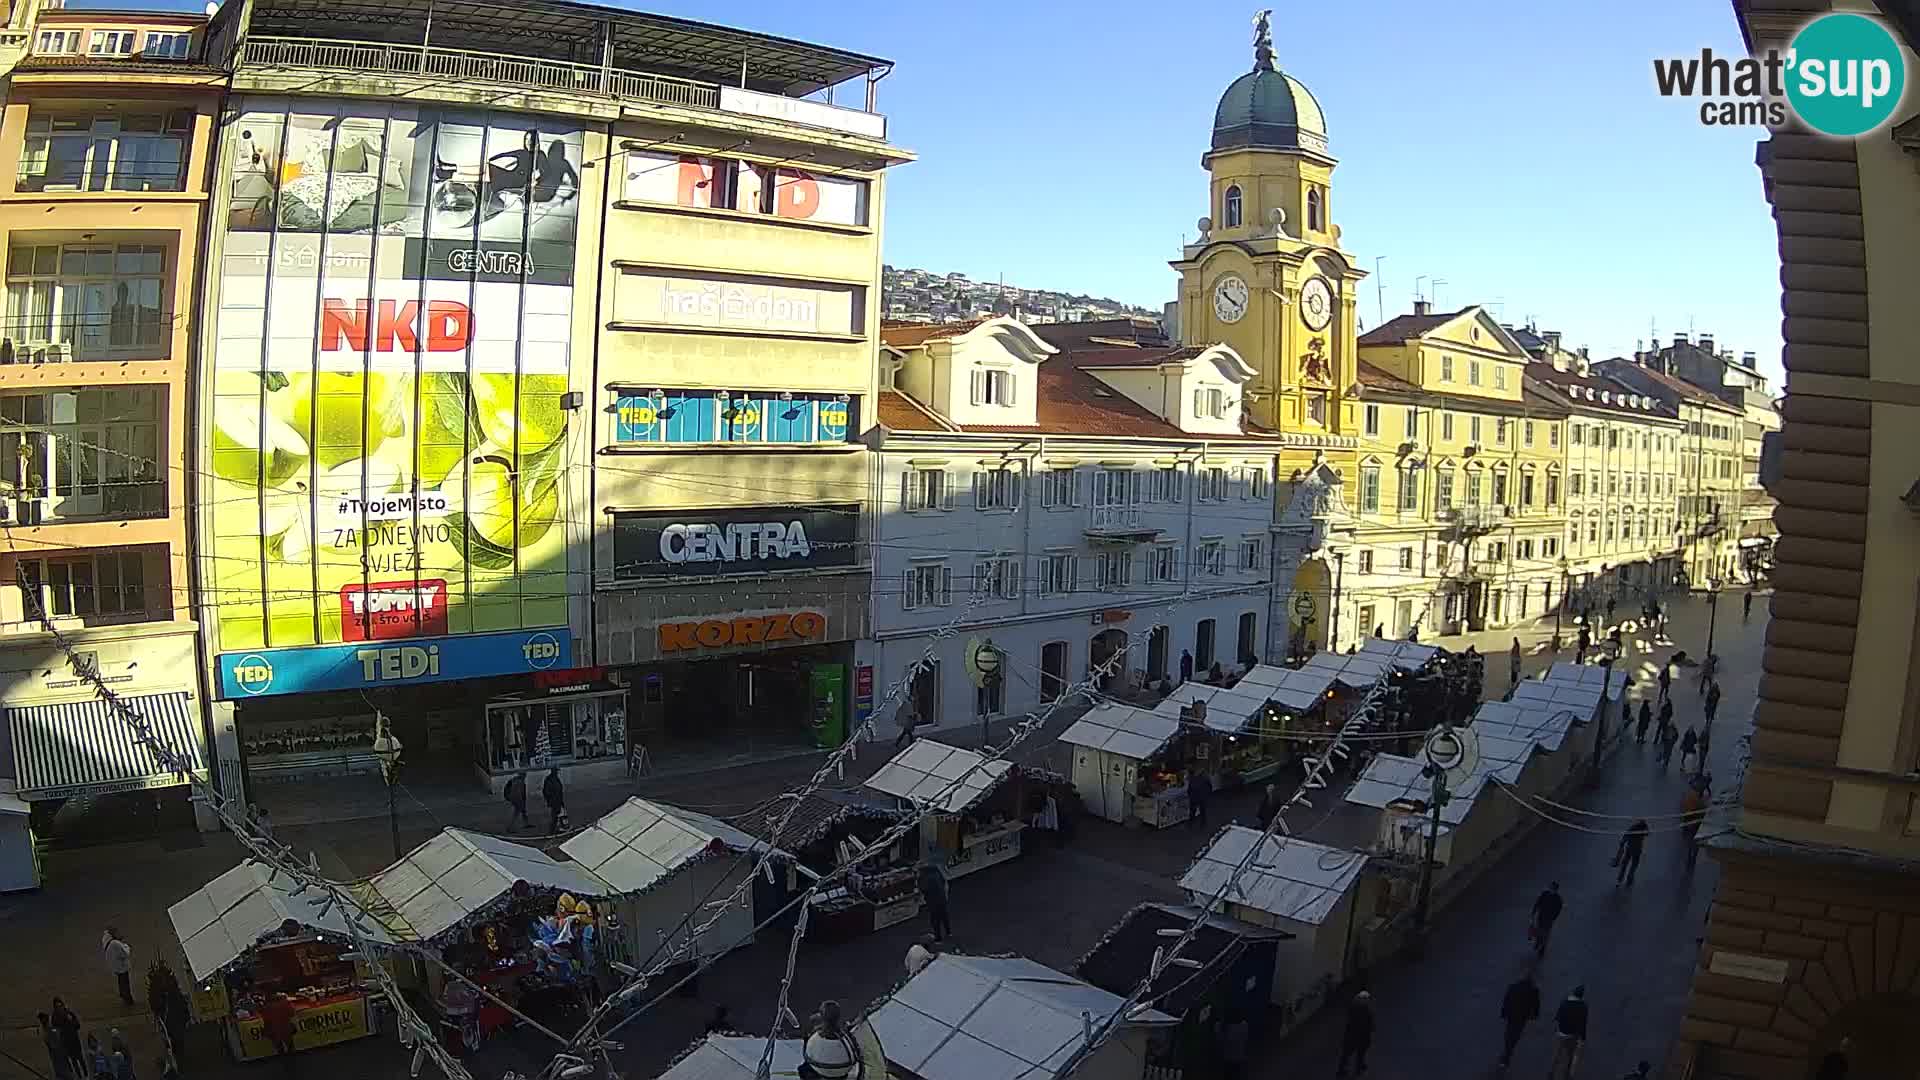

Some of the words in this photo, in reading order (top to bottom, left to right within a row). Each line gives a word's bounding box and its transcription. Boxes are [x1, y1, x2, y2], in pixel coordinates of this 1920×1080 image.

[676, 156, 820, 219] ND
[448, 249, 535, 275] CENTRA
[321, 298, 476, 353] NKD
[334, 528, 358, 548] ZA
[365, 523, 450, 547] DNEVNO
[660, 521, 810, 562] CENTRA
[360, 548, 425, 574] SVJEŽE
[347, 586, 440, 615] TOMMY
[380, 613, 400, 626] ŠTO
[660, 611, 826, 650] KORZO
[358, 646, 441, 682] TEDi
[522, 641, 561, 660] TEDi
[233, 665, 273, 683] TEDi
